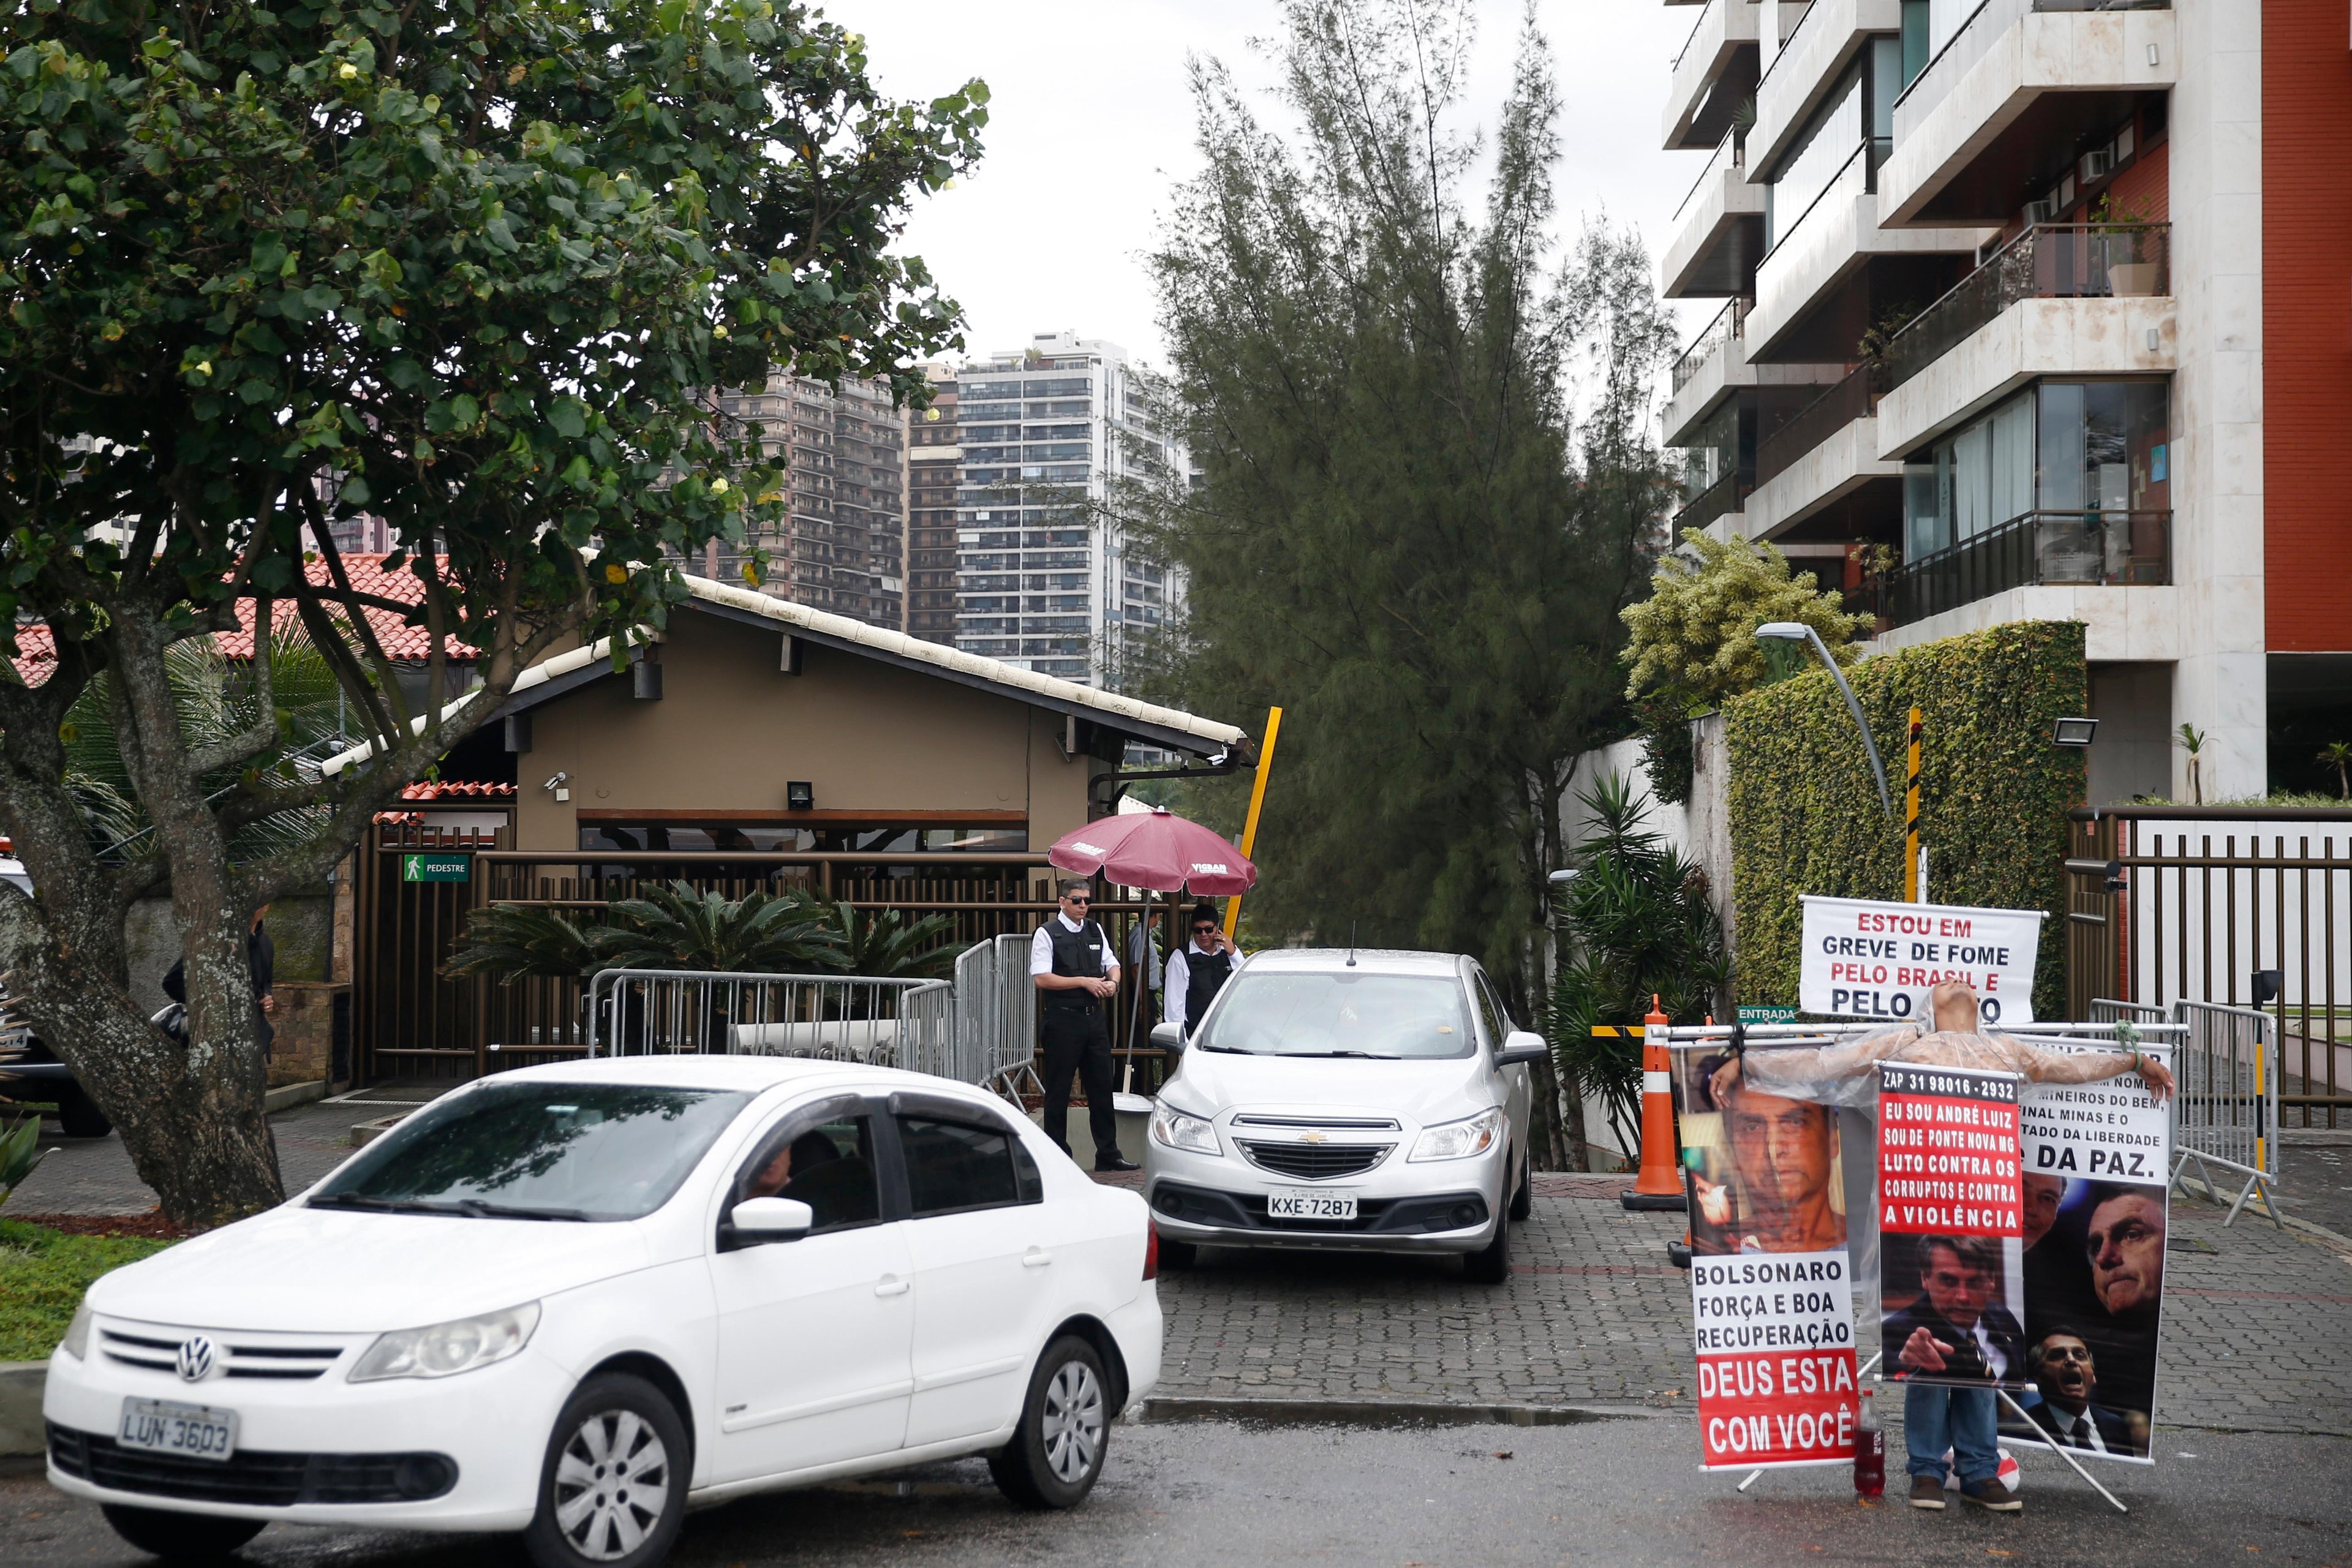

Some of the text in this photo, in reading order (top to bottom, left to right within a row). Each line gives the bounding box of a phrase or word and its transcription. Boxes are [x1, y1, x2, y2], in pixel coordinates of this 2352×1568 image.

[1191, 863, 1226, 872] VIGBAN
[1858, 913, 1971, 938] ESTOU EM
[1822, 936, 2009, 965] GREVE DE FOME
[1831, 962, 1887, 984] PELO
[1986, 973, 1999, 991] E
[1739, 1009, 1795, 1019] ENTRADA
[1831, 989, 1911, 1017] PELO
[1884, 1071, 1903, 1088] ZAP
[1910, 1074, 1924, 1090] 31
[1886, 1102, 2011, 1128] EU SOU ANDRÉ LUIZ
[2109, 1095, 2127, 1106] DO
[2133, 1097, 2165, 1112] BEM,
[2060, 1110, 2103, 1123] MINAS
[2108, 1111, 2114, 1125] É
[2120, 1114, 2128, 1125] O
[1885, 1128, 2014, 1153] SOU DE PONTE NOVA MG
[2063, 1128, 2080, 1140] DA
[2086, 1131, 2160, 1147] LIBERDADE
[1885, 1153, 2015, 1177] LUTO CONTRA OS
[2037, 1145, 2078, 1171] DA
[2089, 1149, 2154, 1177] PAZ.
[1885, 1180, 2016, 1202] CORRUPTOS E CONTRA
[1885, 1204, 2017, 1228] A VIOLÊNCIA
[1695, 1261, 1841, 1286] BOLSONARO
[1699, 1292, 1834, 1321] FORÇA E BOA
[1697, 1318, 1849, 1349] RECUPERAÇÃO
[1699, 1356, 1853, 1398] DEUS ESTA
[1709, 1415, 1770, 1453] COM
[1777, 1403, 1852, 1449] VOCÊ
